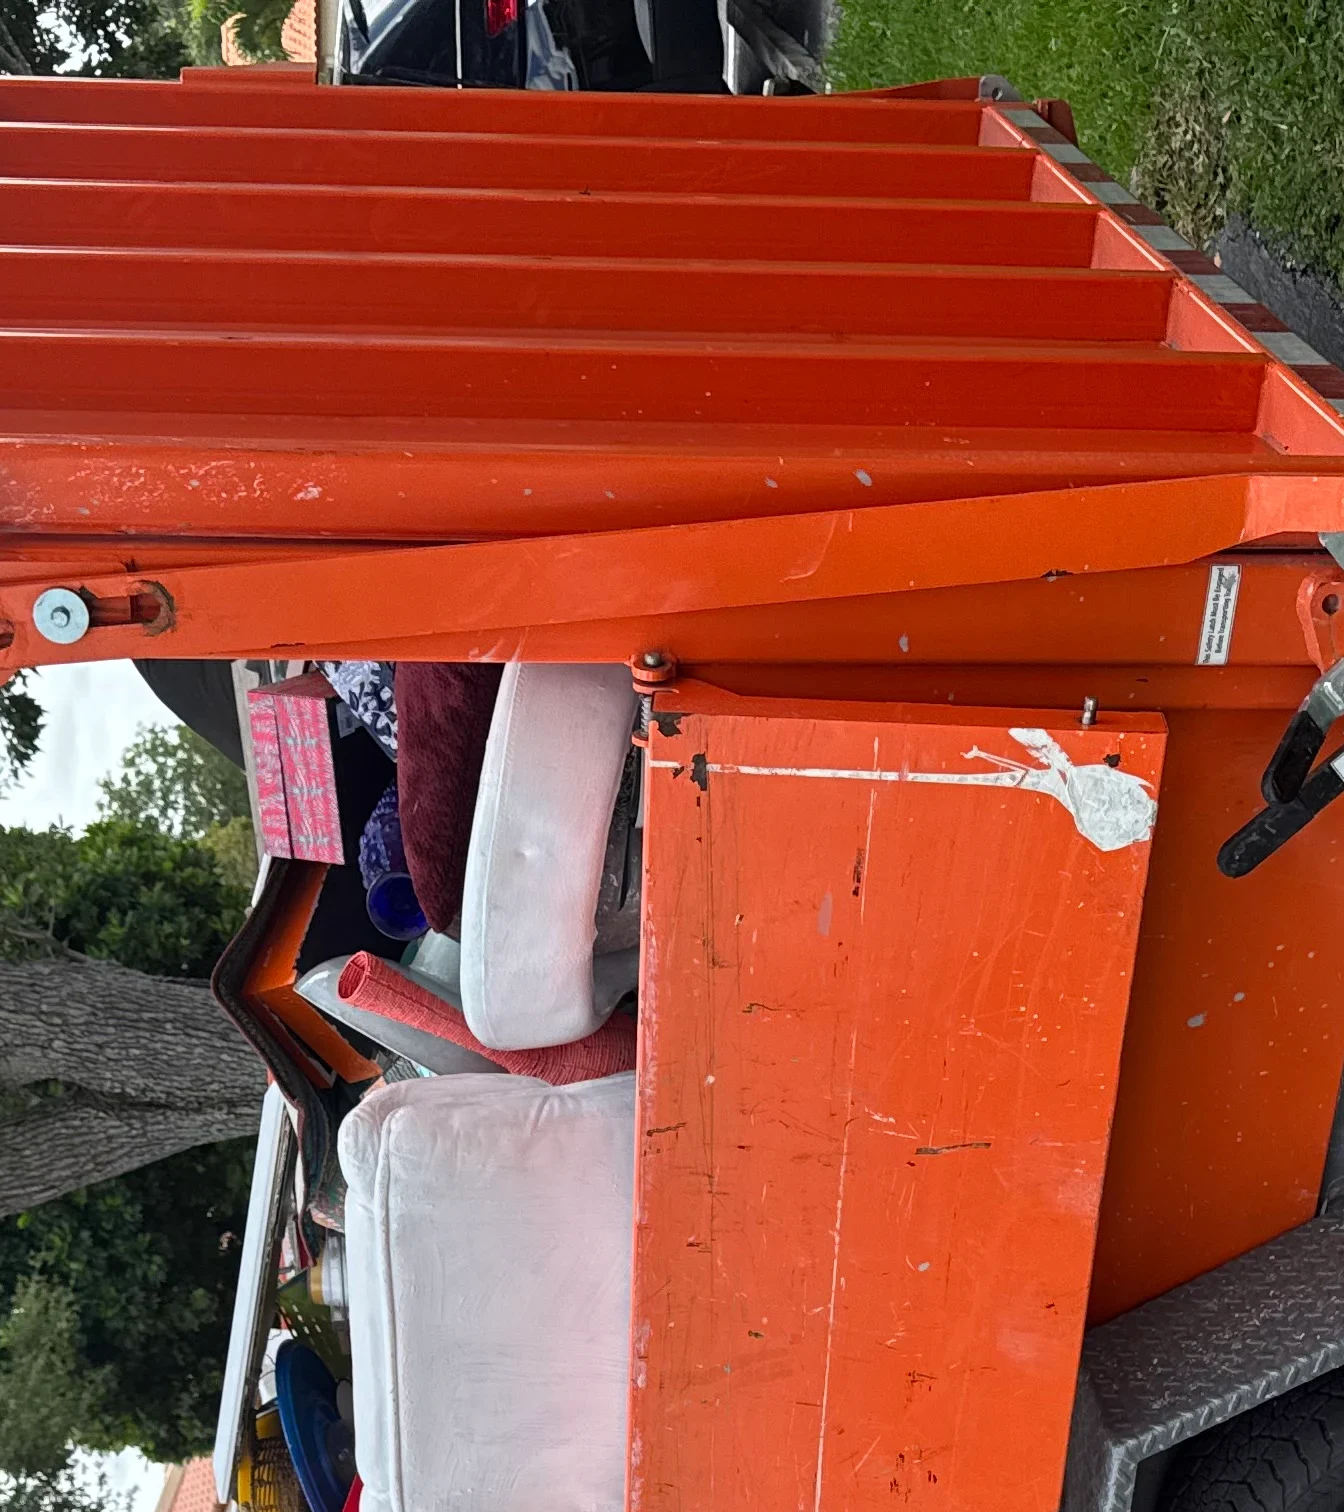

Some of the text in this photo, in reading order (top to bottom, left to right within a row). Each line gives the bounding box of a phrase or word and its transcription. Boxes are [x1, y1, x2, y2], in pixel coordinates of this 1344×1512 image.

[1210, 603, 1219, 617] Must
[1218, 598, 1231, 634] Transporting
[1208, 618, 1216, 633] Latch
[1205, 635, 1215, 652] Safety
[1215, 635, 1224, 653] Before
